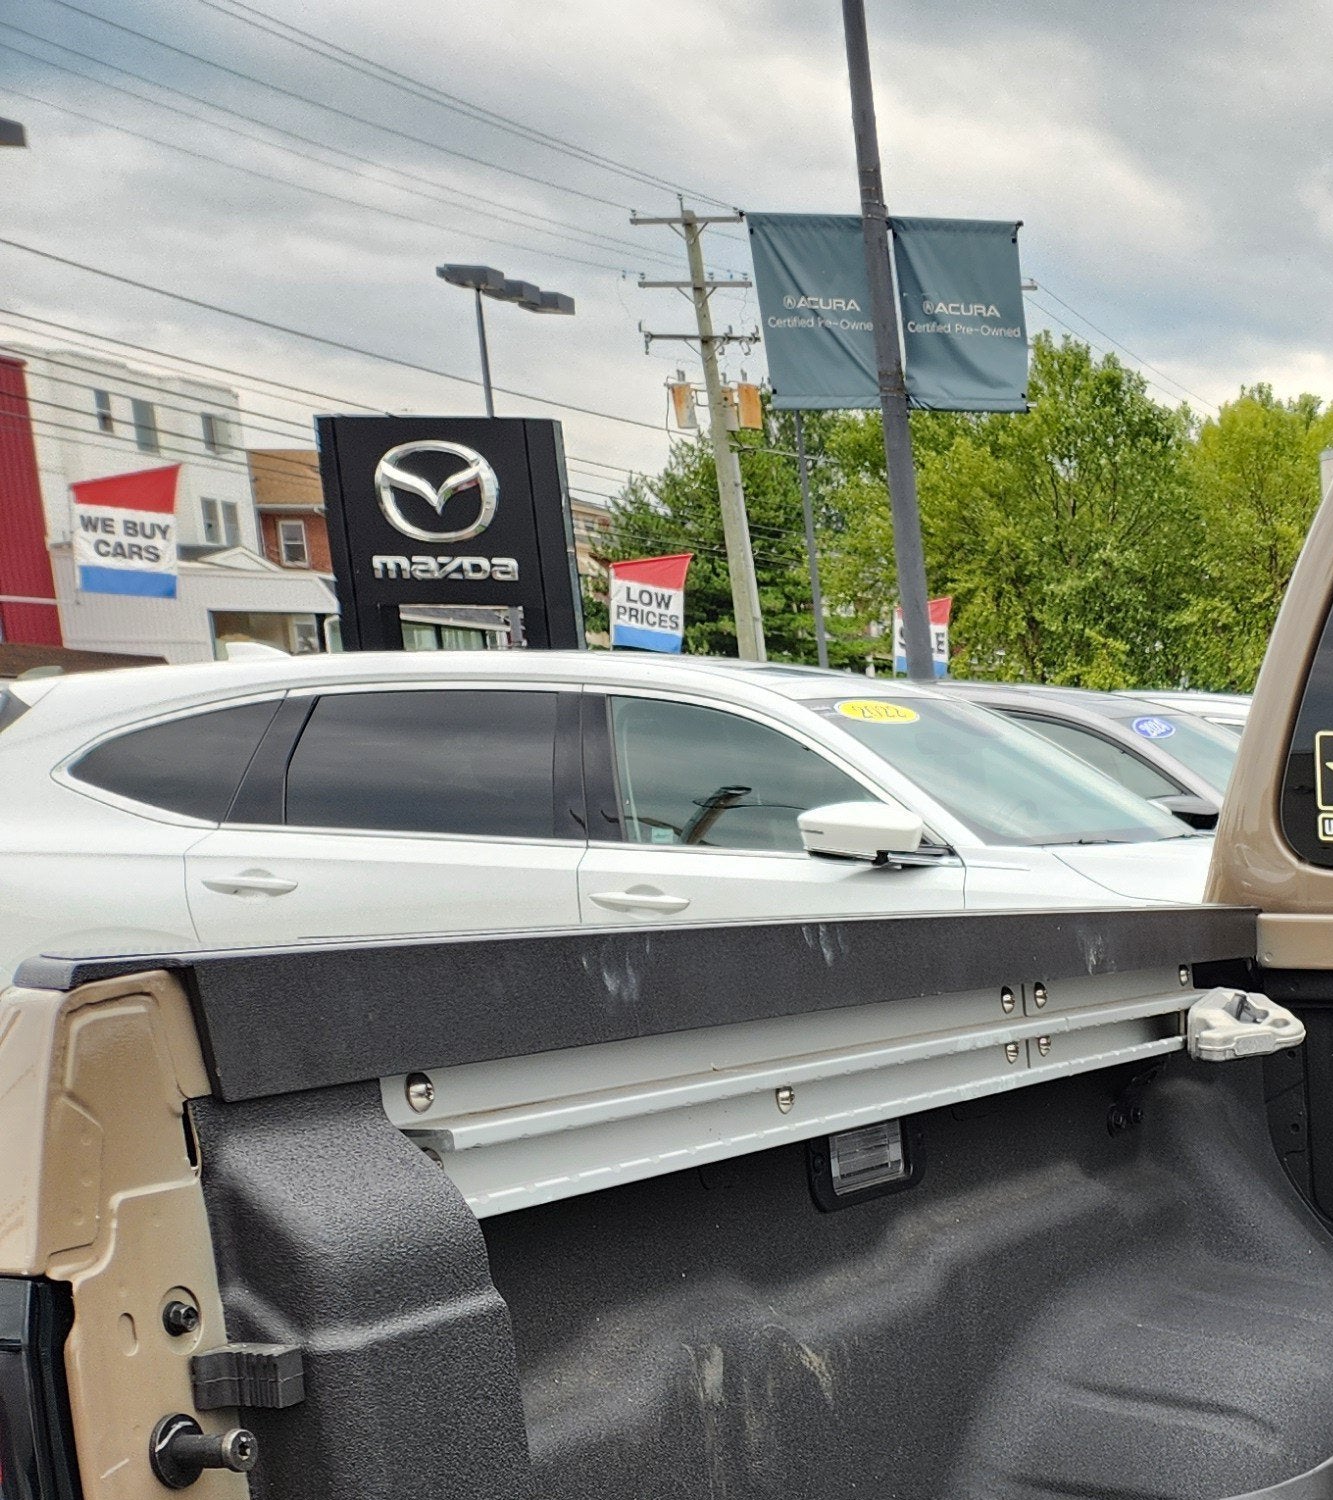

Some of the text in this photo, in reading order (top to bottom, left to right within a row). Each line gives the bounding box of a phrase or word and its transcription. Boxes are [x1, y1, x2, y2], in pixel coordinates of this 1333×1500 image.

[797, 296, 860, 311] ACURA
[934, 302, 1001, 318] ACURA
[768, 316, 814, 328] Certified
[907, 321, 1020, 337] Certified Pre-Owned
[80, 515, 170, 540] WE BUY
[94, 539, 161, 562] CARS
[626, 586, 672, 610] LOW
[617, 605, 679, 630] PRICES
